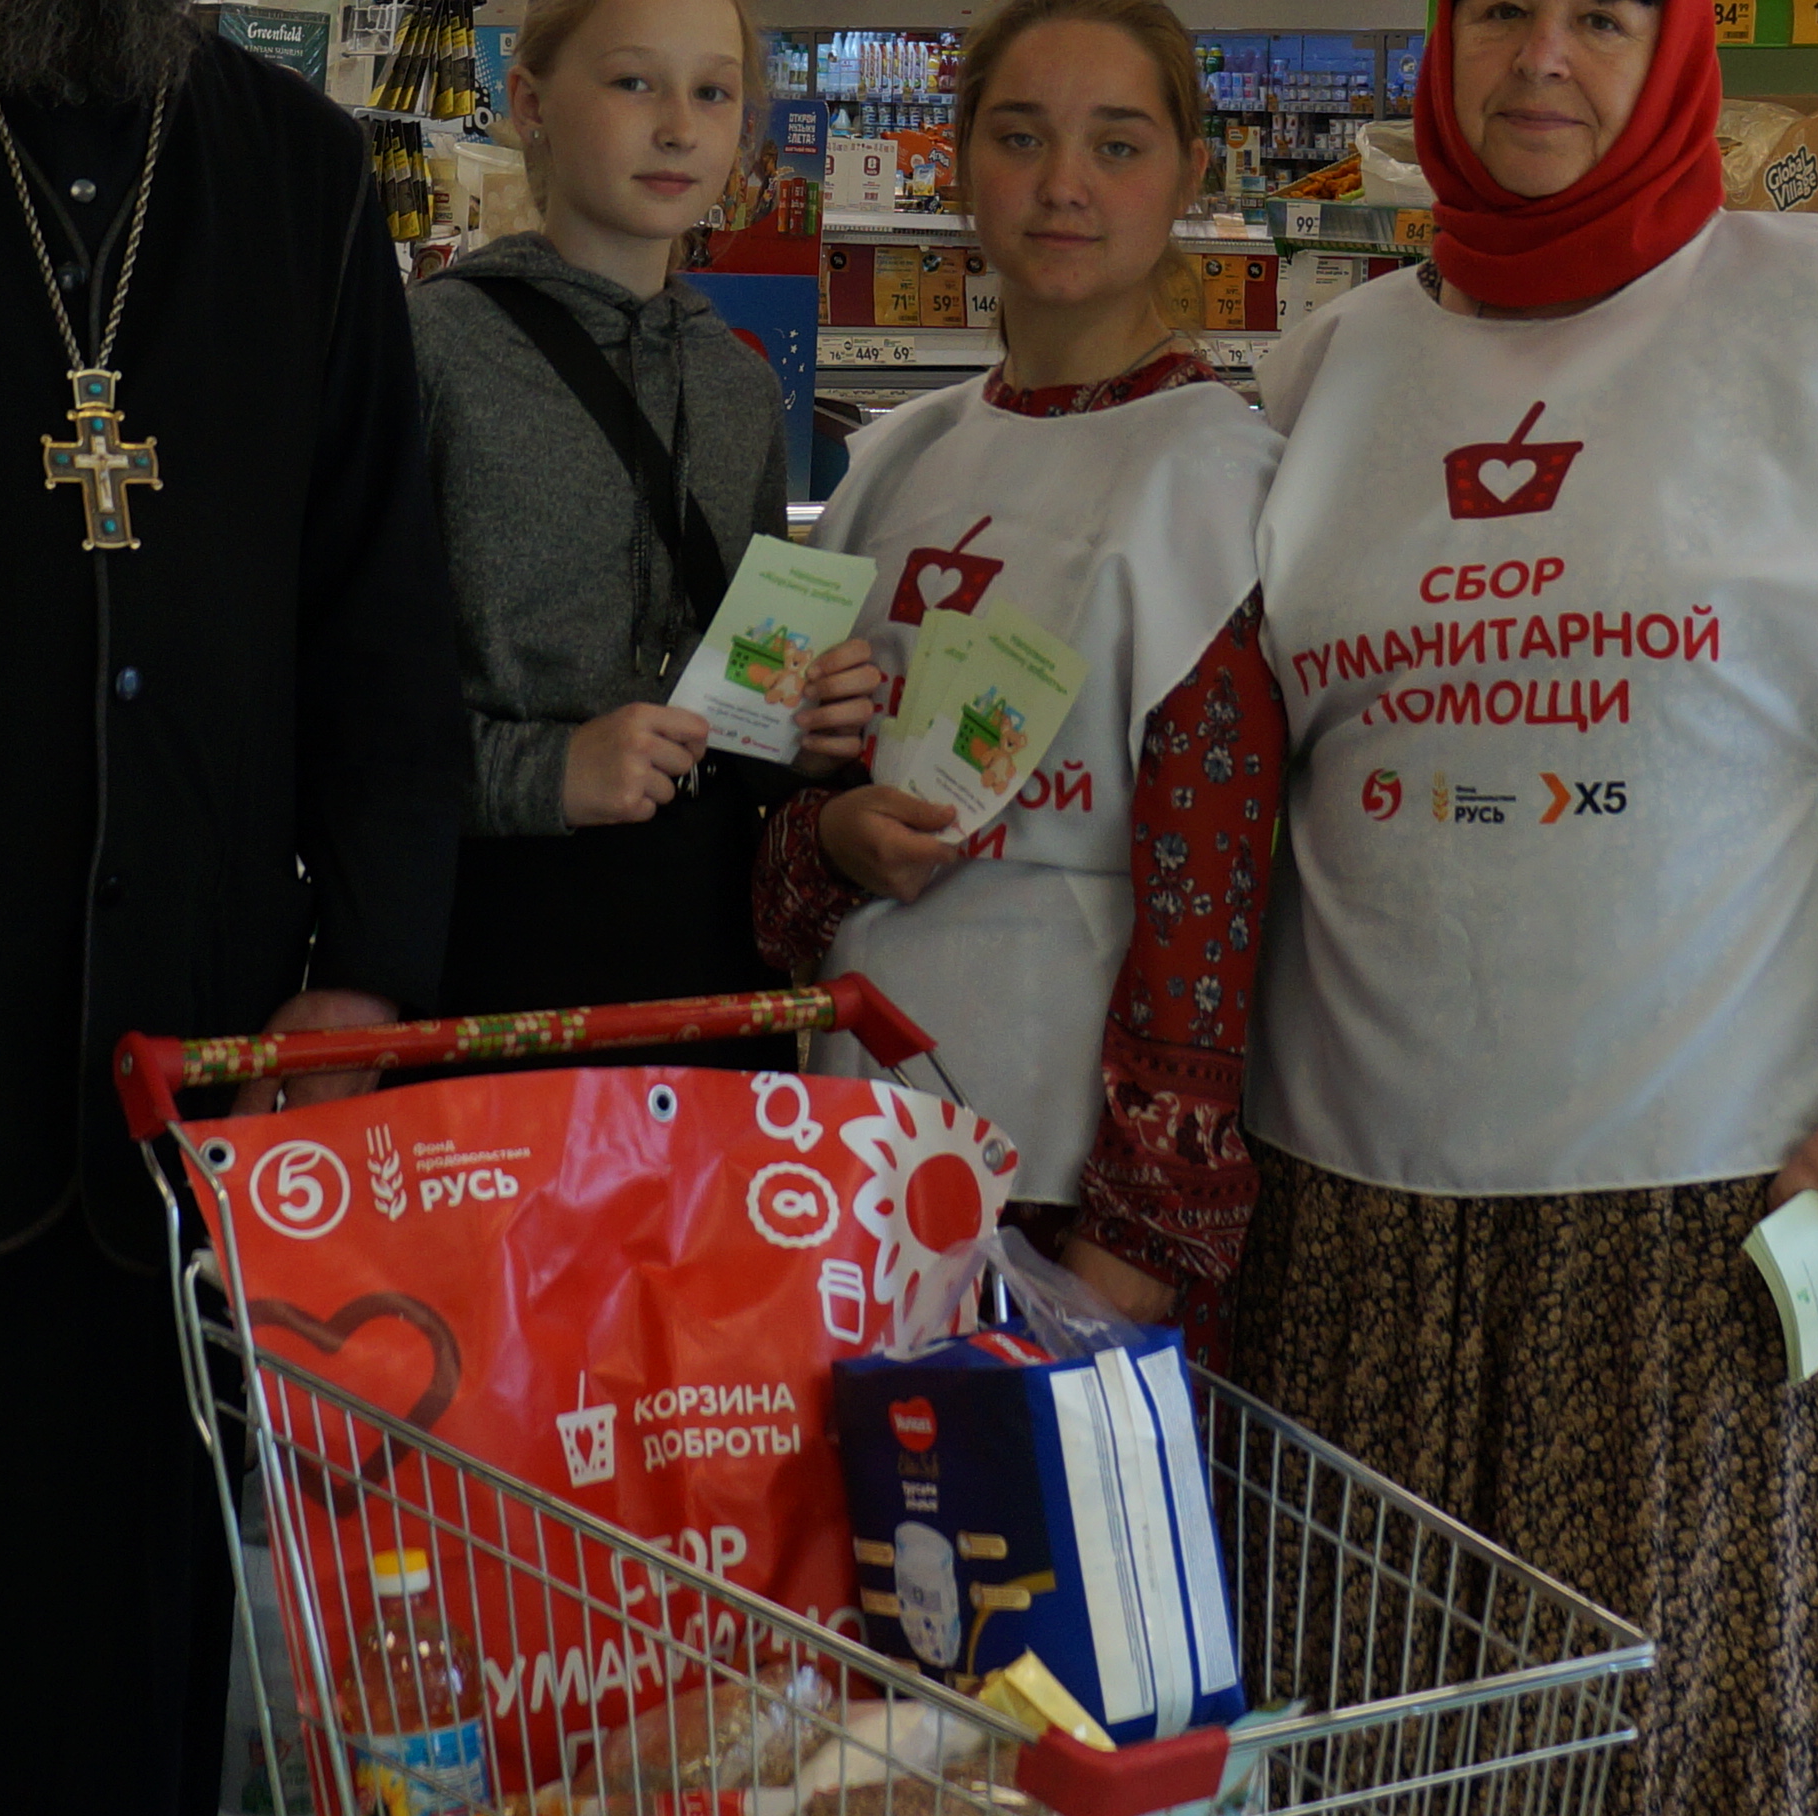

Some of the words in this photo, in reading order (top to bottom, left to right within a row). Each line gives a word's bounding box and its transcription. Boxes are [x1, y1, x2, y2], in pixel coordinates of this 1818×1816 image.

[246, 21, 304, 43] Greenfield
[1295, 215, 1315, 233] 99
[1405, 223, 1425, 241] 84
[891, 294, 909, 311] 71
[932, 295, 952, 312] 59
[1216, 298, 1235, 315] 79
[855, 347, 880, 361] 449
[893, 347, 910, 361] 69
[1419, 556, 1566, 605] СБОР
[1291, 604, 1721, 697] ГУМАНИТАРНОЙ
[1361, 678, 1631, 733] ПОМОЩИ
[1573, 780, 1628, 816] X5
[1454, 804, 1506, 825] РУСЬ
[412, 1139, 456, 1157] Фонд
[418, 1167, 520, 1213] РУСЬ
[632, 1383, 797, 1422] КОРЗИНА
[644, 1424, 802, 1472] ДОБРОТЫ
